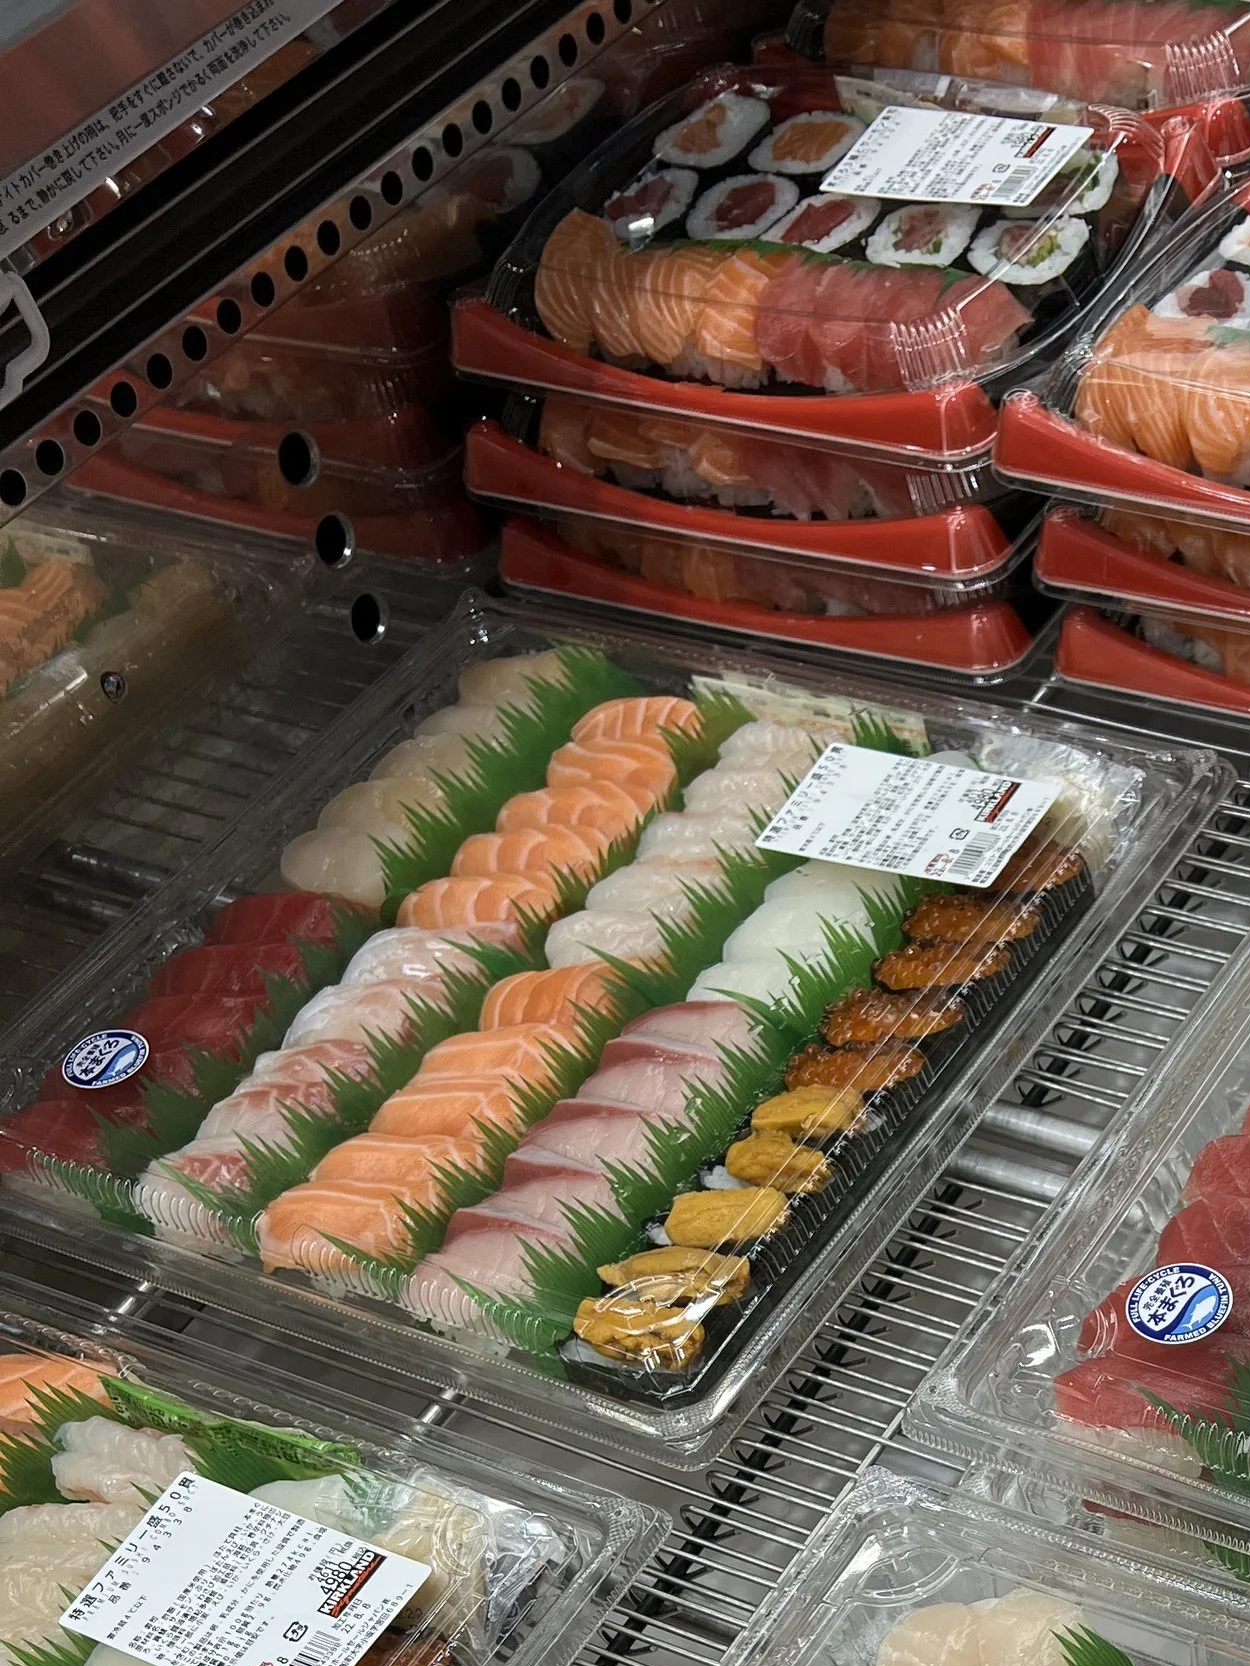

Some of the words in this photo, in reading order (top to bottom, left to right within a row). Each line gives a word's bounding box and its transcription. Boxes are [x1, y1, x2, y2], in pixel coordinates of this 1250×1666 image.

[976, 781, 1012, 820] KIRKLAND
[79, 1039, 119, 1077] 本まぐろ
[1143, 1279, 1172, 1310] 完全養殖
[1209, 1273, 1228, 1296] TUNA
[1130, 1302, 1141, 1323] FULL
[1147, 1276, 1195, 1326] 本まぐろ
[1207, 1298, 1229, 1328] BLUEFIN
[1164, 1328, 1206, 1341] FARMED
[148, 1511, 176, 1540] COMBO
[68, 1476, 195, 1622] 特選ファミリー盛50貫
[314, 1560, 338, 1583] 4611
[316, 1560, 355, 1596] 4980
[319, 1550, 377, 1613] KIRKLAND
[331, 1598, 362, 1630] 加工年月日
[340, 1620, 356, 1634] 22.
[352, 1610, 364, 1619] 8.
[275, 1655, 289, 1664] 8
